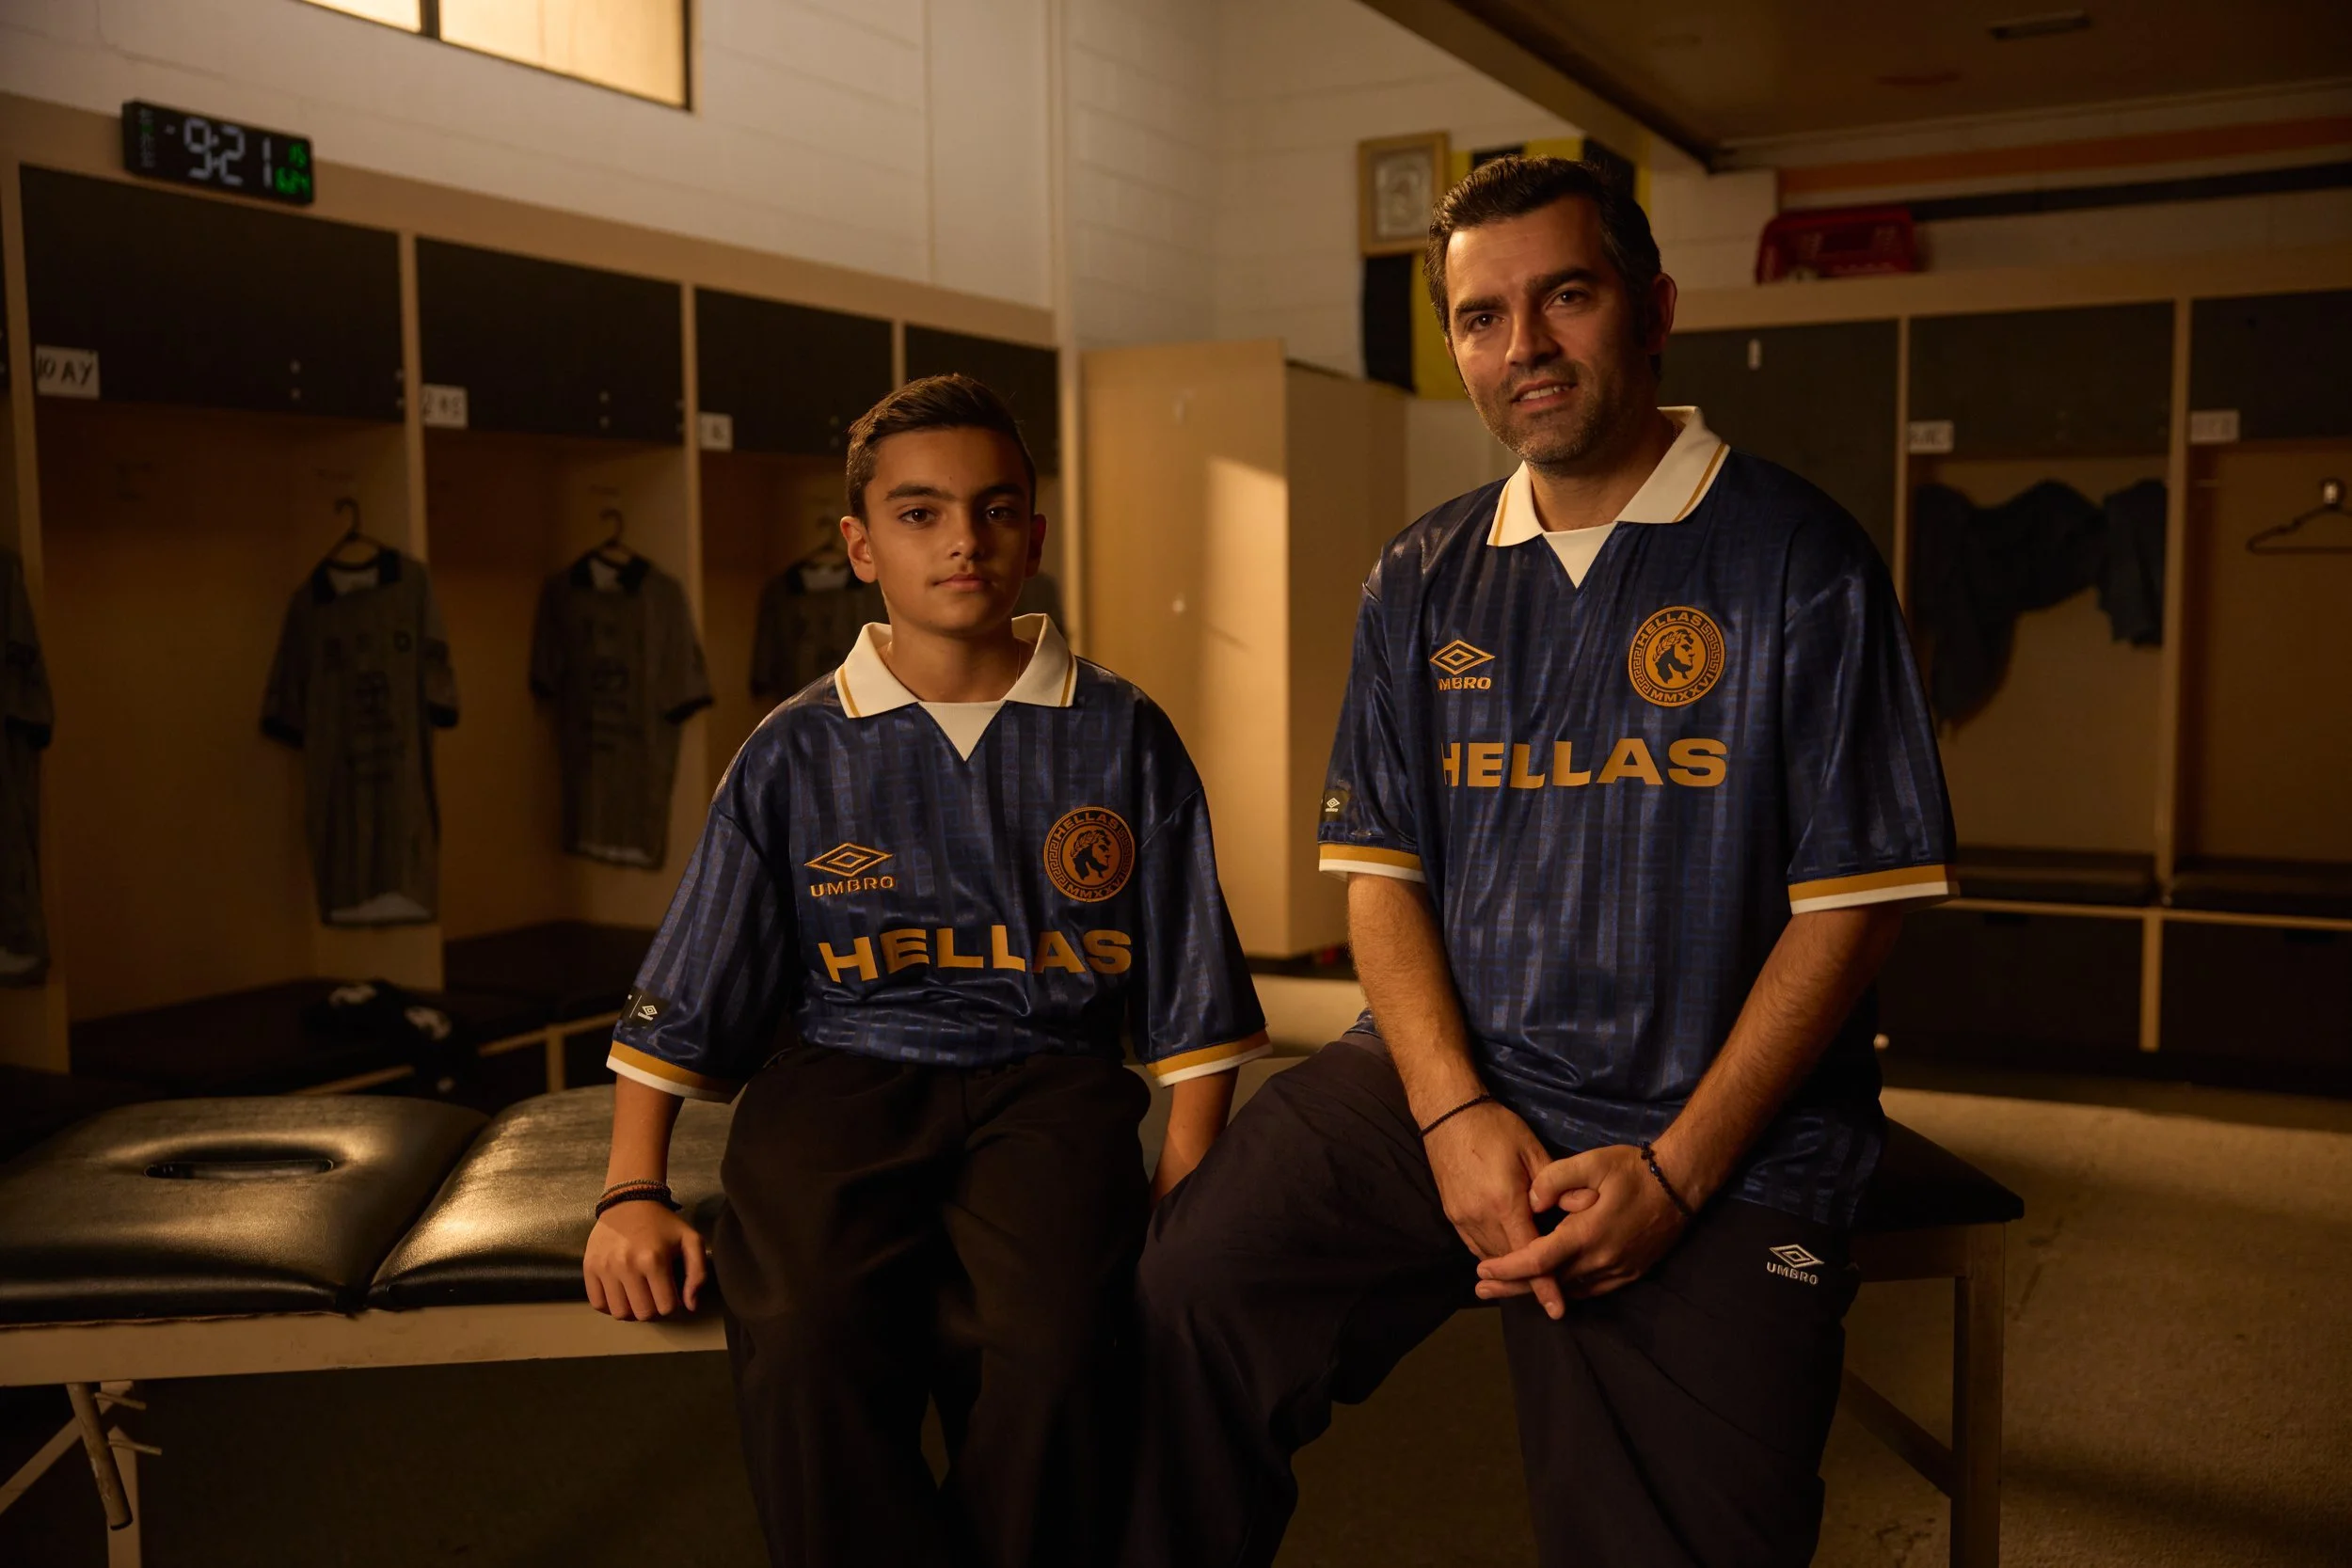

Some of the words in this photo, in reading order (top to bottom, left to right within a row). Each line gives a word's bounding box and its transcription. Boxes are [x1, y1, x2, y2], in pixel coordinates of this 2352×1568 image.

[1638, 611, 1703, 646] HELLAS
[1651, 673, 1711, 703] MMXXVI
[1440, 737, 1728, 789] HELLAS
[1053, 811, 1121, 840] HELLAS
[810, 876, 896, 897] UMBRO
[818, 924, 1133, 983] HELLAS
[1766, 1261, 1820, 1286] UMBRO
